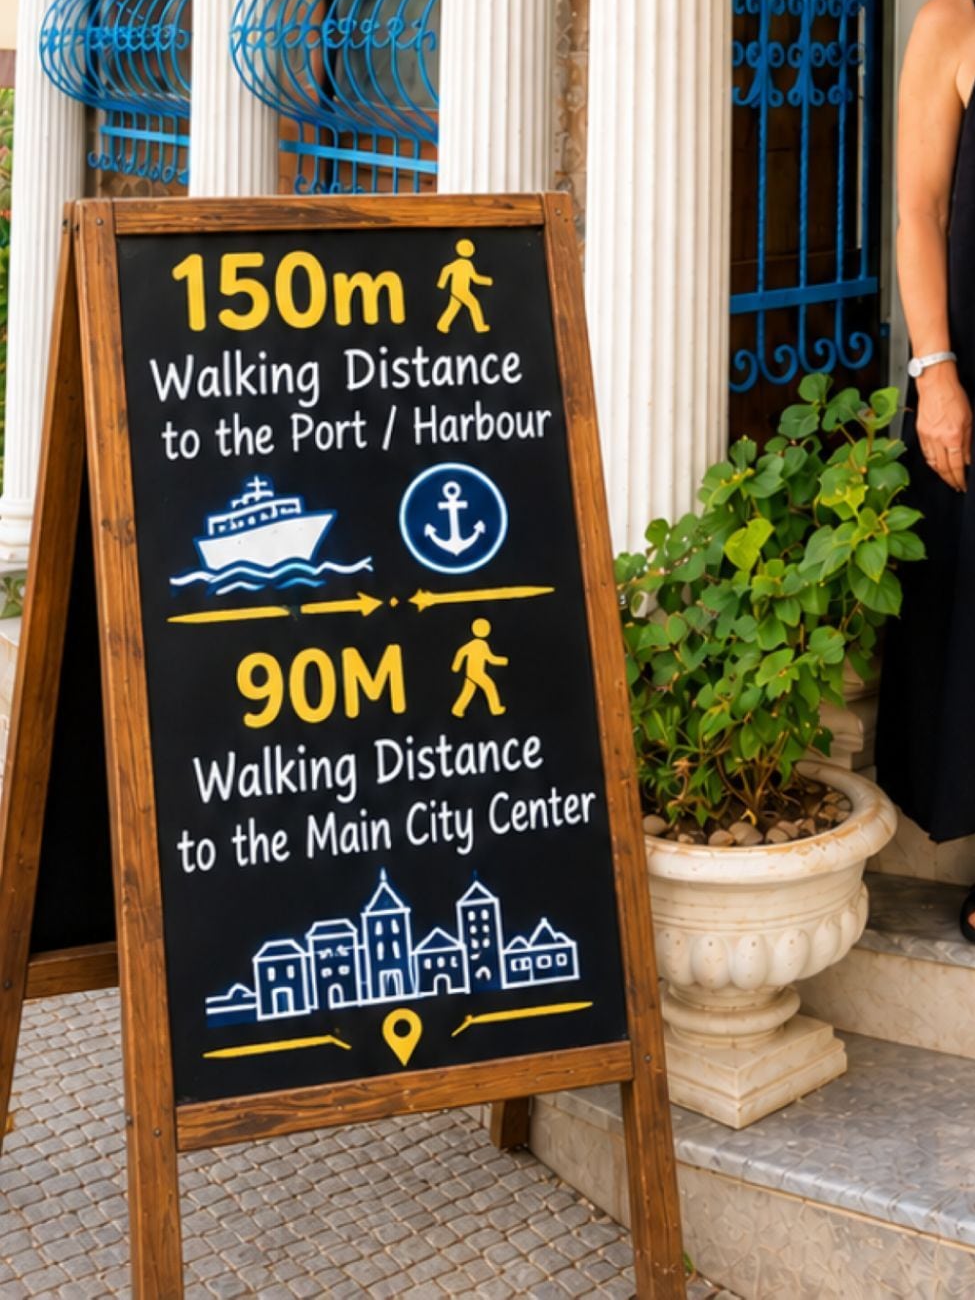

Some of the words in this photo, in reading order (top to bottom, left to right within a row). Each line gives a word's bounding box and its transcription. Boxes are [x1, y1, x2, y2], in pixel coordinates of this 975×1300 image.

[171, 250, 406, 332] 150m
[149, 349, 321, 408] Walking
[343, 345, 523, 391] Distance
[161, 421, 200, 461] to
[214, 412, 275, 458] the
[290, 410, 368, 452] Port
[382, 404, 397, 451] /
[413, 400, 552, 446] Harbour
[236, 643, 407, 729] 90M
[192, 744, 357, 804] Walking
[374, 734, 544, 784] Distance
[176, 830, 217, 873] to
[231, 817, 290, 868] the
[306, 808, 392, 859] Main
[406, 800, 474, 855] City
[488, 787, 596, 835] Center
